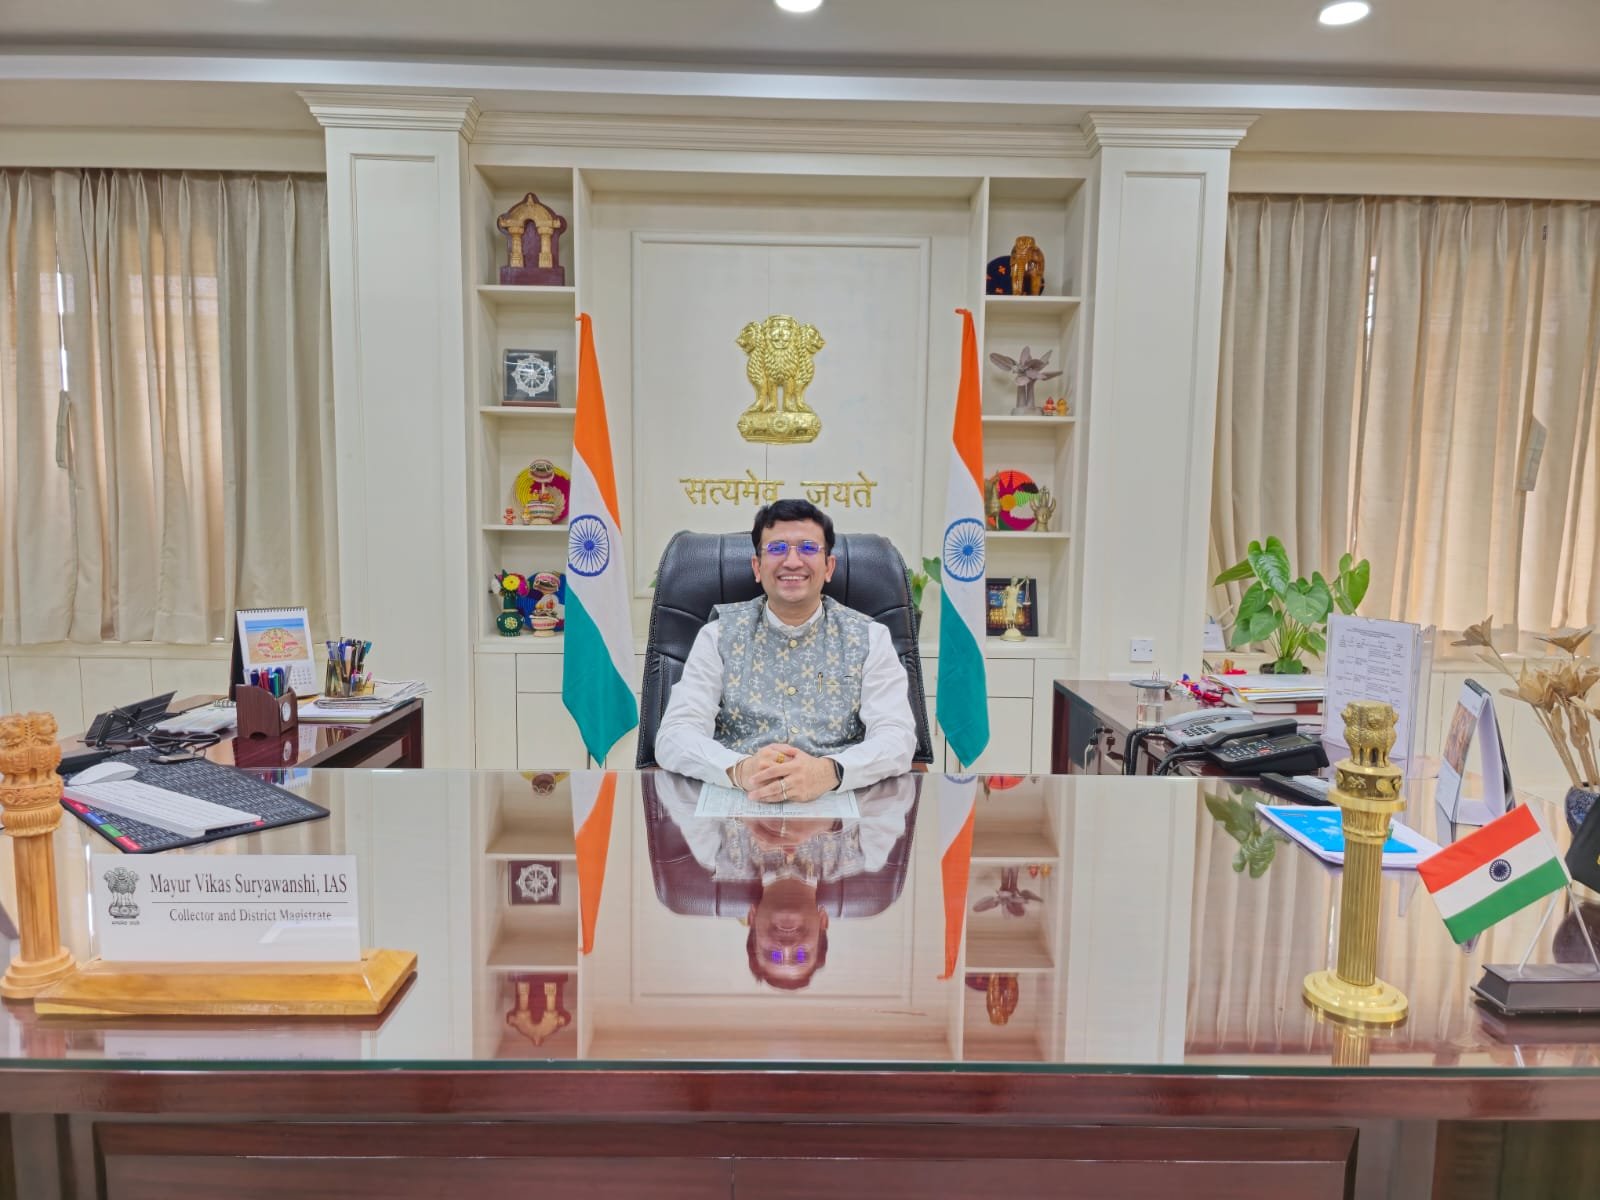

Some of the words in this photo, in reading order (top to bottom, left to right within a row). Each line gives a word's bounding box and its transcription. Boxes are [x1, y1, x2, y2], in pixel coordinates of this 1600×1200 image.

[680, 469, 785, 506] सत्यमेव
[800, 471, 878, 508] जयते
[150, 873, 191, 898] Mayur
[195, 873, 232, 893] Vikas
[235, 873, 320, 898] Suryawanshi,
[324, 873, 347, 893] IAS
[169, 908, 214, 921] Collector
[218, 908, 236, 921] and
[239, 908, 276, 921] District
[280, 908, 332, 924] Magistrate
